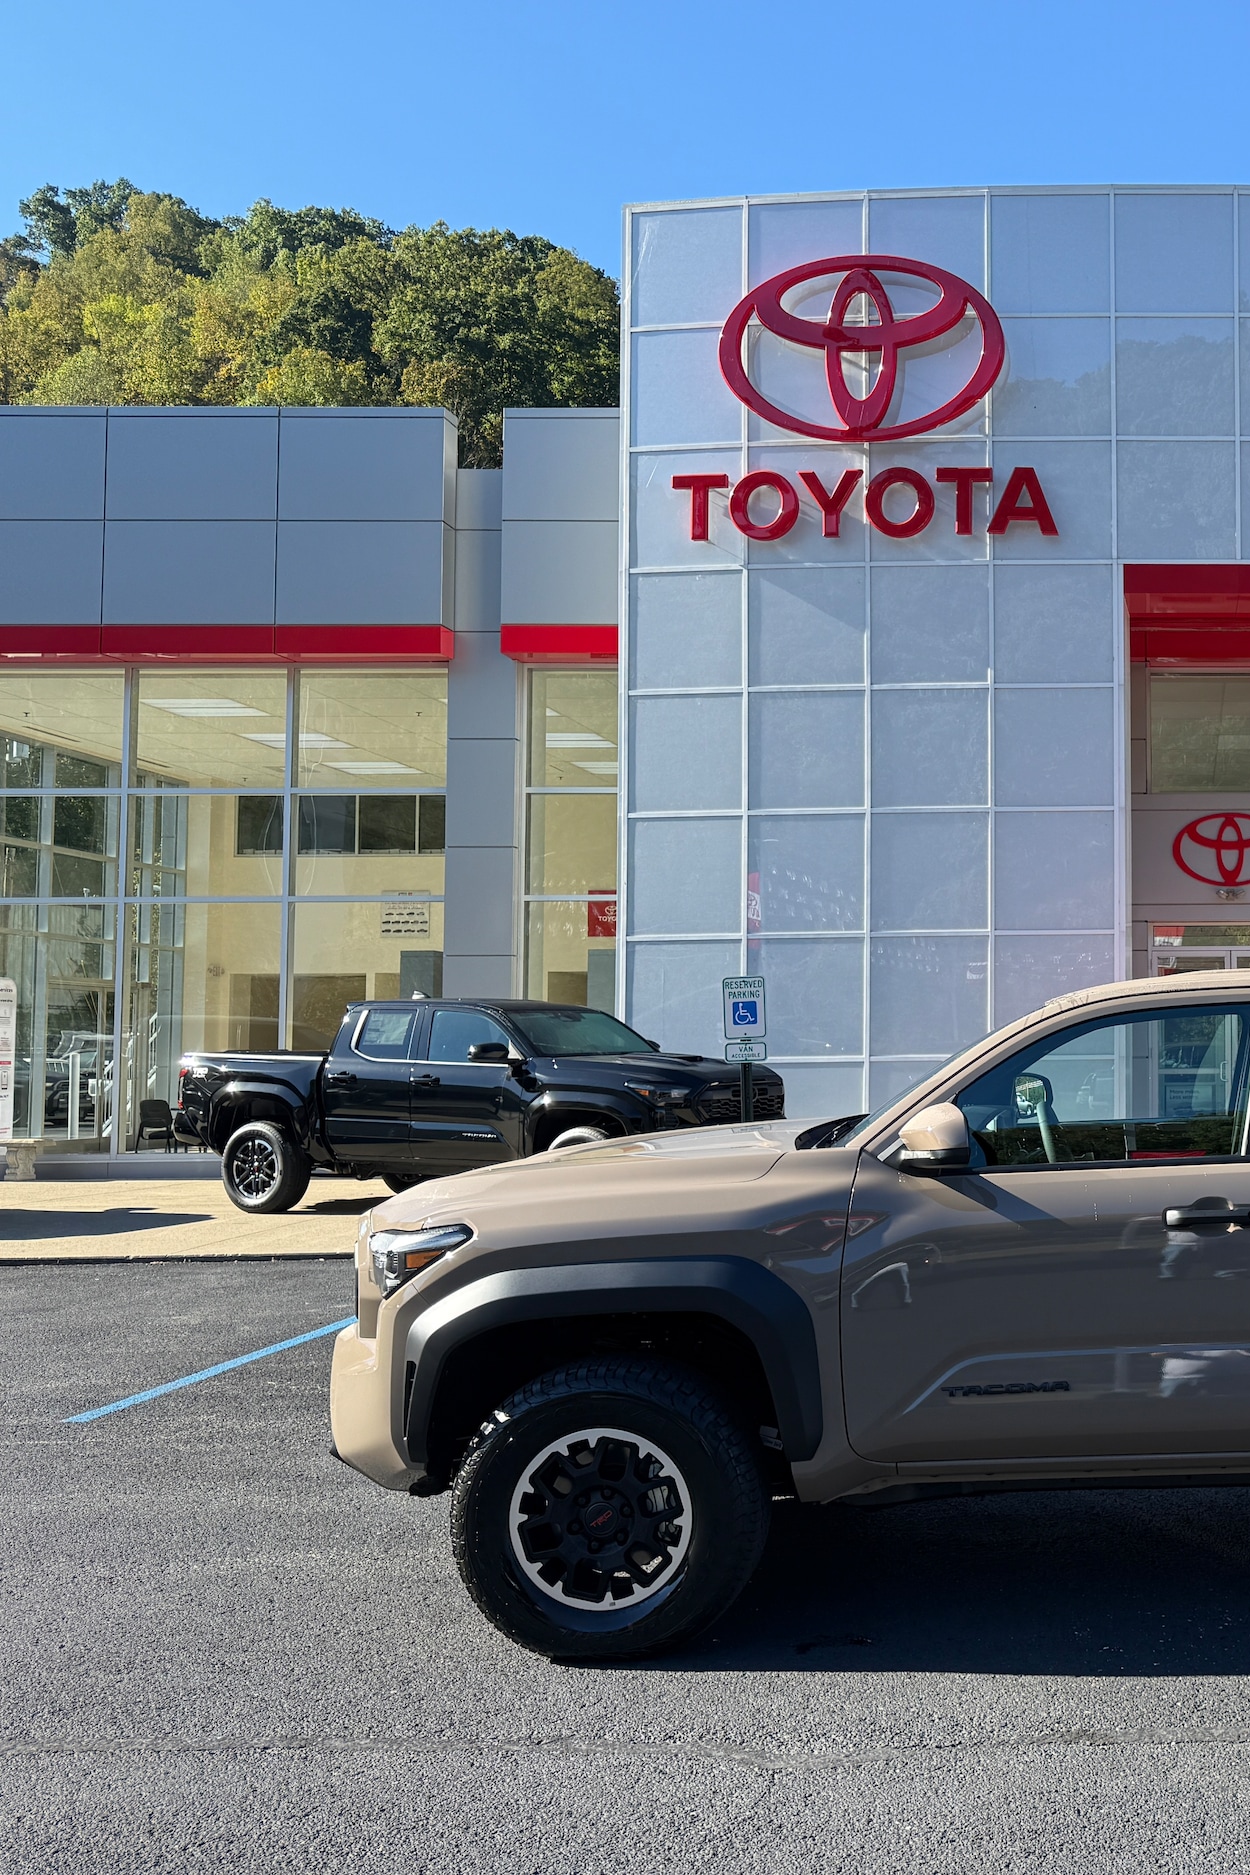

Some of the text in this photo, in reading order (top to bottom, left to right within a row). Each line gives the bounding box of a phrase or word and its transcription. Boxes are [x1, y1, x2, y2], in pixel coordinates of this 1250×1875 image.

[671, 467, 1059, 541] TOYOTA
[725, 980, 762, 989] RESERVED
[728, 990, 760, 999] PARKING
[941, 1381, 1070, 1397] TACOMA
[590, 1510, 612, 1527] TRD
